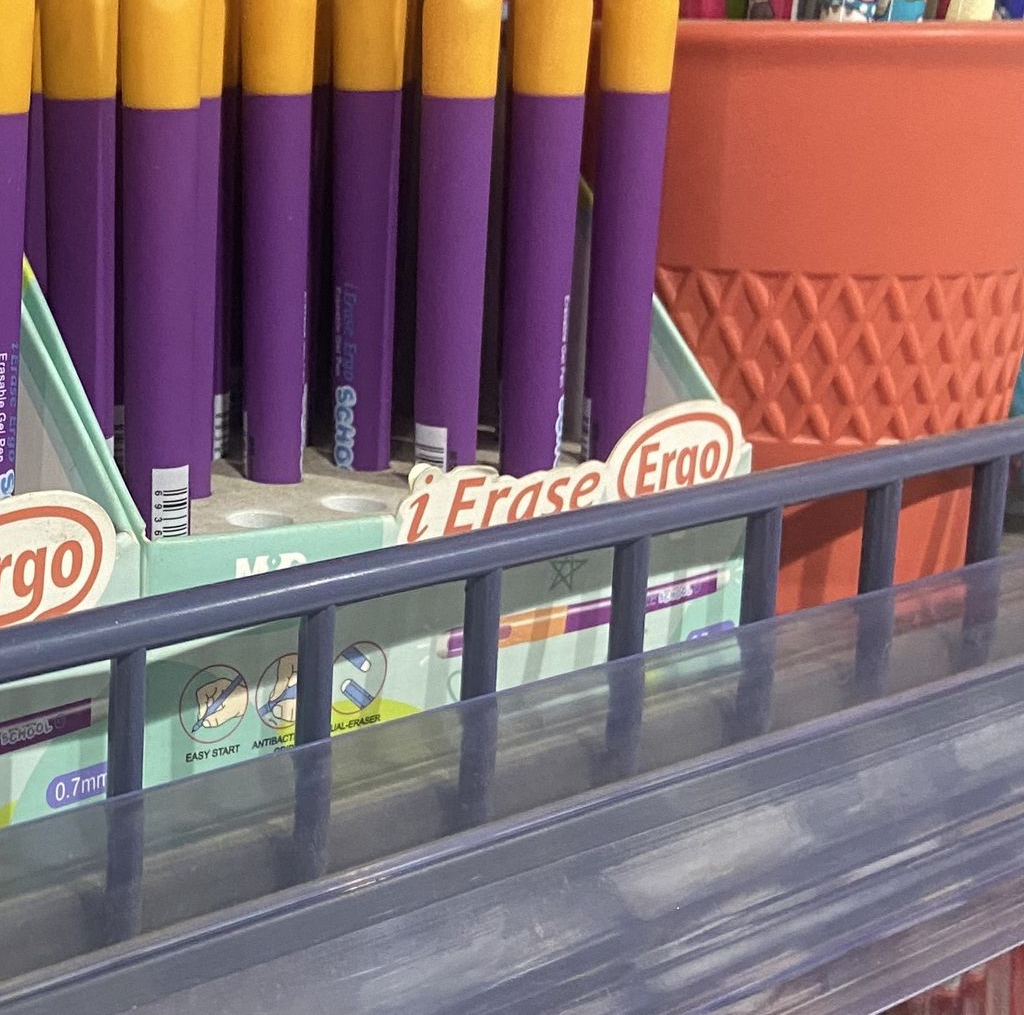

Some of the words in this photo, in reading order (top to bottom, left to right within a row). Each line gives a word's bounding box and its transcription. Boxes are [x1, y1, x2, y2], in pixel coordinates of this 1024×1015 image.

[406, 474, 435, 543] i
[443, 470, 602, 536] Erase
[635, 440, 722, 495] Ergo
[330, 714, 381, 733] UAL-ERASER
[251, 733, 295, 750] ANTIBACT
[185, 749, 211, 763] EASY
[212, 744, 241, 759] START
